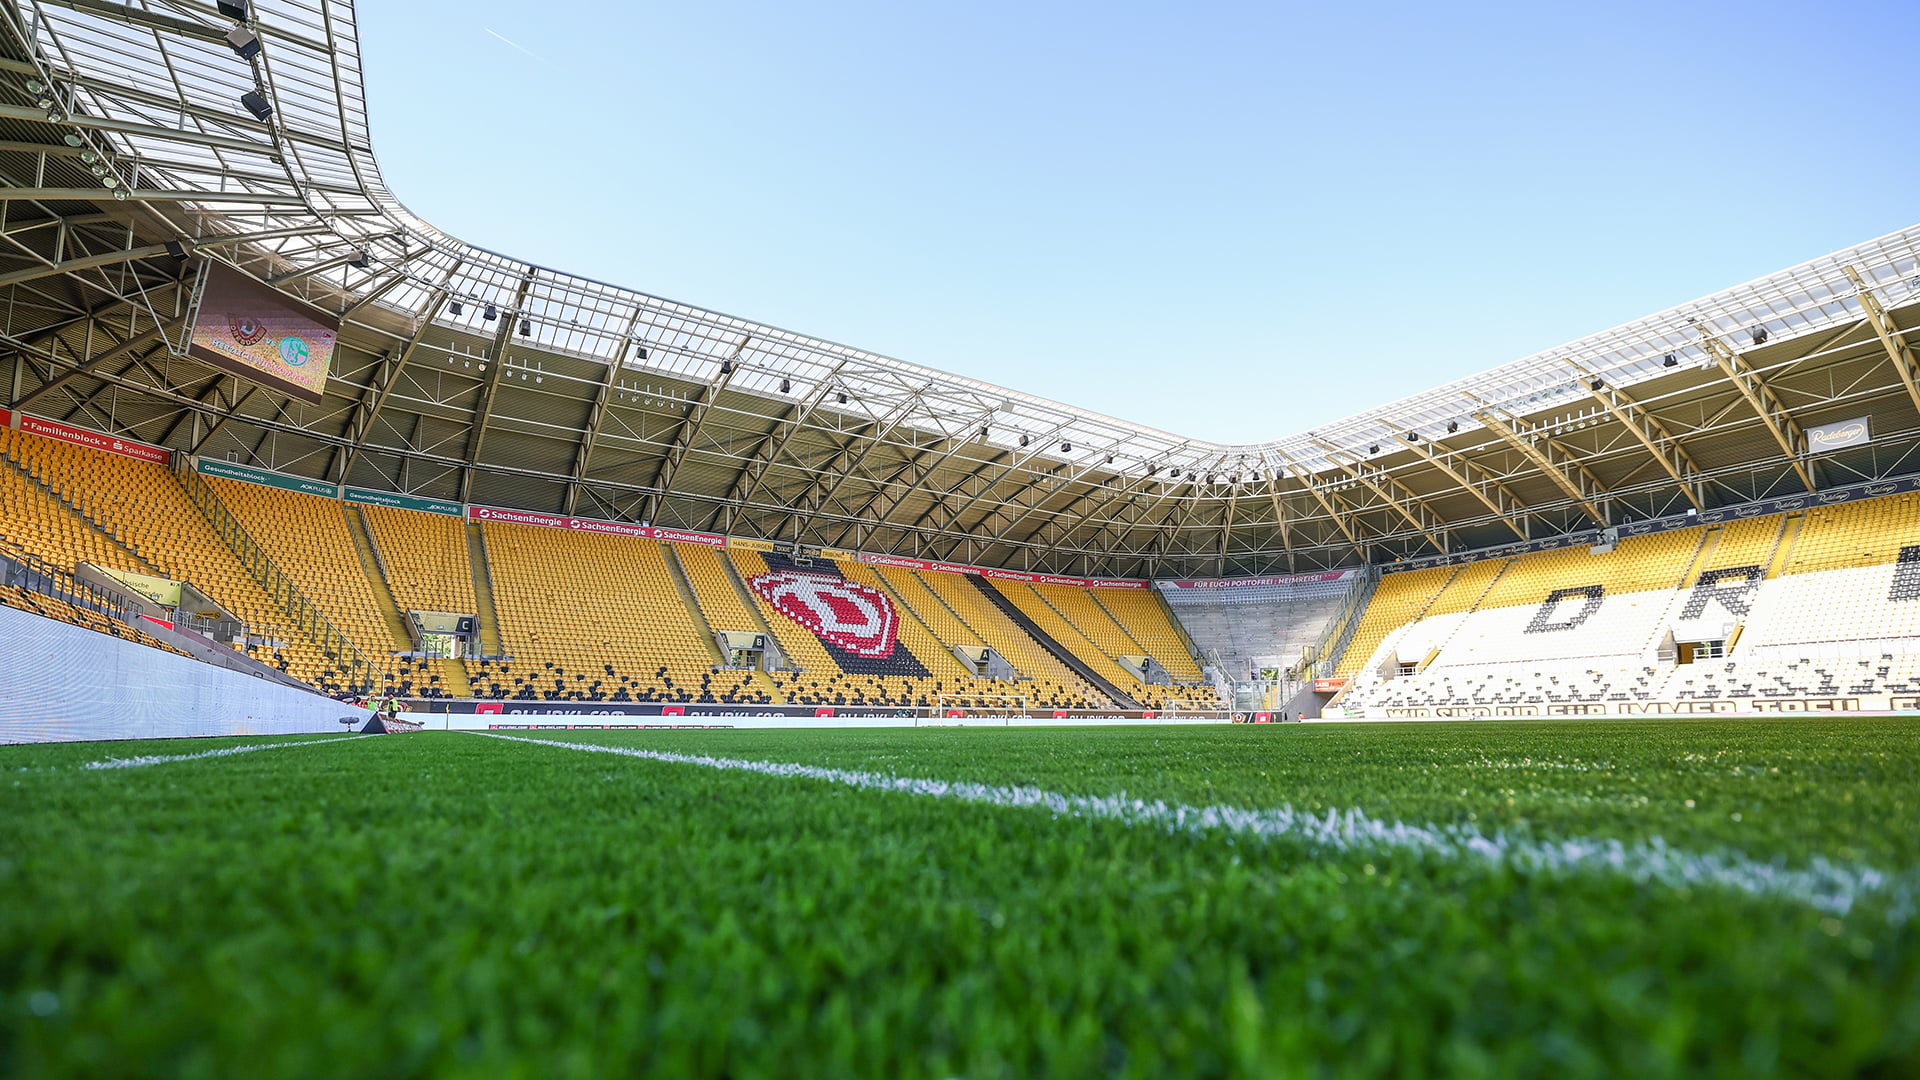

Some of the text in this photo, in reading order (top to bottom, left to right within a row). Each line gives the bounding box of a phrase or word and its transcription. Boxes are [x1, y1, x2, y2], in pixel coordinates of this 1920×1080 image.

[31, 422, 101, 446] Familienblock
[124, 445, 163, 461] Sparkasse
[204, 464, 266, 482] Gesundheitsblock
[491, 511, 562, 527] SachsenEnergie
[581, 522, 646, 536] SachsenEnergie
[663, 531, 722, 545] SachsenEnergie
[879, 557, 923, 568] SachsenEnergie
[938, 564, 980, 575] SachsenEnergie
[1193, 580, 1208, 588] FÜR
[1209, 580, 1230, 588] EUCH
[462, 621, 470, 630] C
